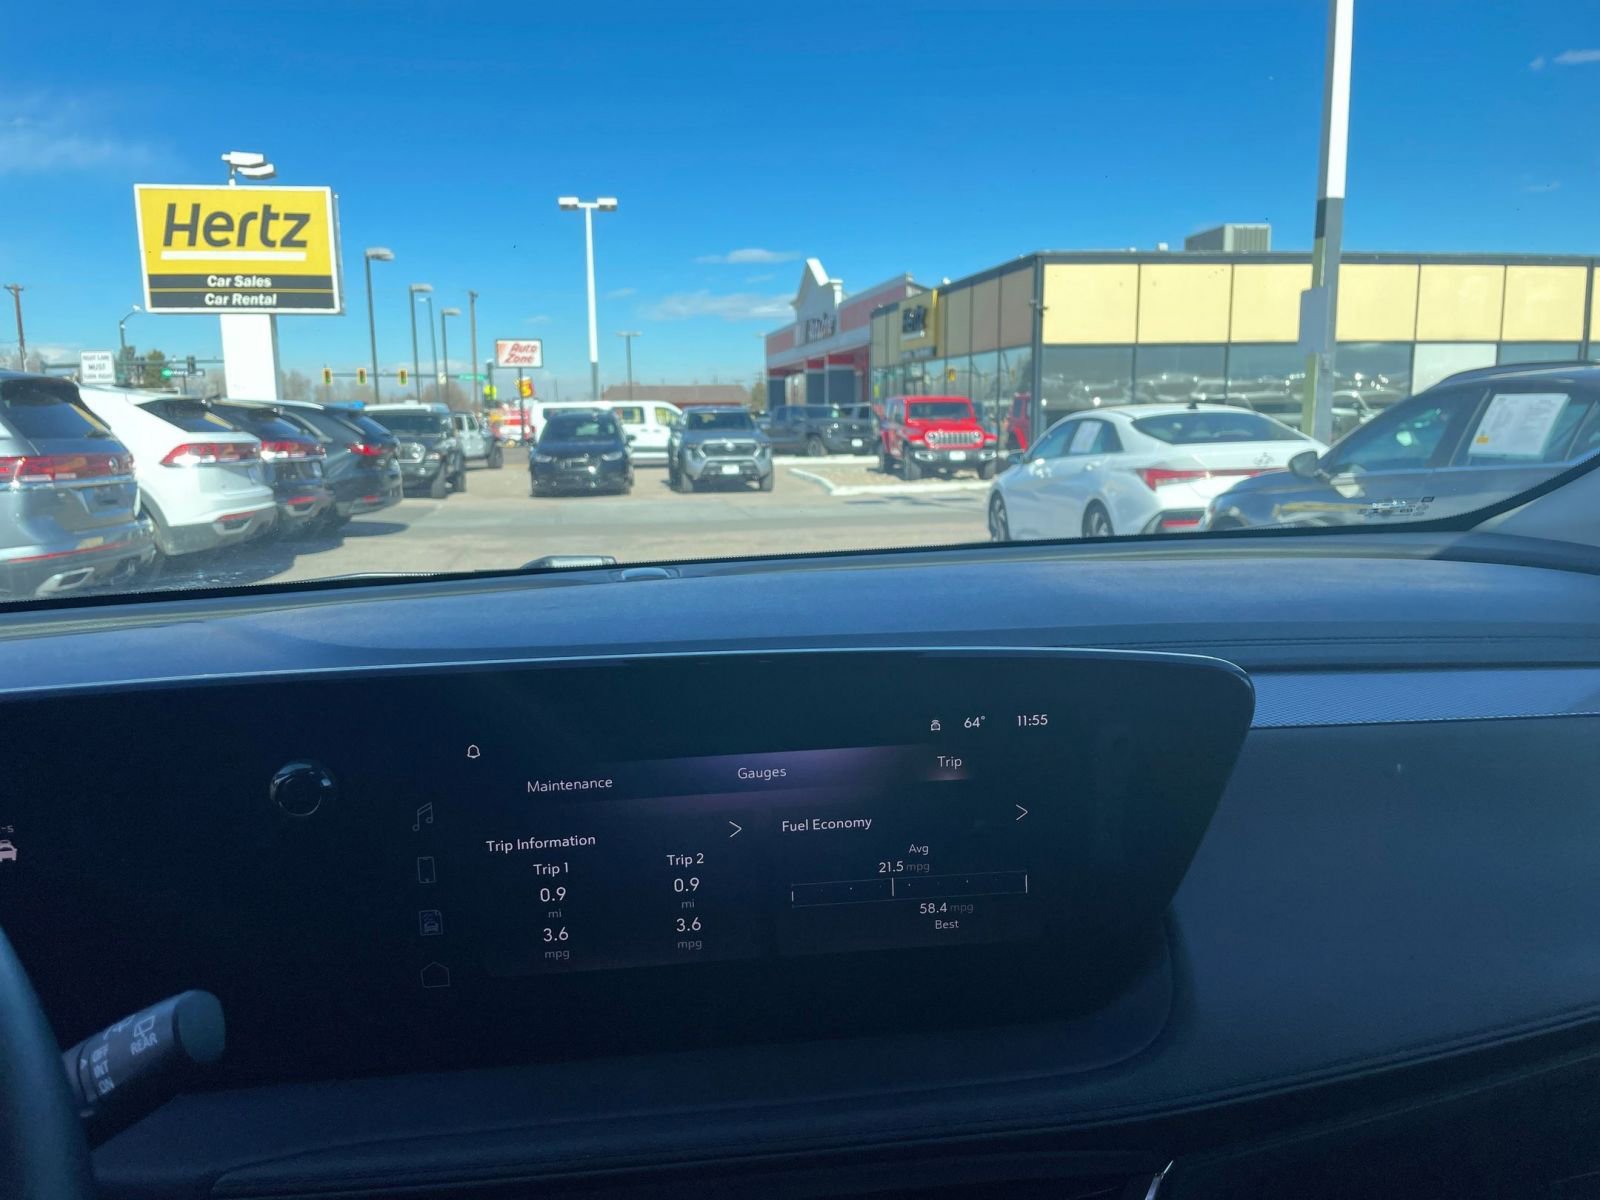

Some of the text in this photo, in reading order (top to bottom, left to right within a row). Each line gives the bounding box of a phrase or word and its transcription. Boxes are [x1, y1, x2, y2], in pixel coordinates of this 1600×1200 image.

[163, 203, 311, 248] Hertz
[207, 275, 272, 287] Car Sales
[204, 293, 277, 306] Car Rental
[511, 343, 538, 353] Auto
[506, 353, 534, 363] Zone
[1017, 714, 1048, 727] 11:55
[937, 755, 962, 769] Trip
[737, 766, 787, 780] Gauges
[527, 776, 613, 793] Maintenance
[782, 817, 872, 832] Fuel Economy
[486, 835, 596, 854] Trip Information
[908, 843, 929, 856] Avg
[666, 853, 704, 867] Trip 2
[533, 862, 569, 877] Trip 1
[879, 861, 930, 874] 21.5 mpg
[673, 877, 700, 893] 0.9
[539, 886, 567, 903] 0.9
[681, 899, 695, 909] mi
[919, 902, 974, 915] 58.4 mpg
[548, 909, 562, 919] mi
[676, 917, 702, 932] 3.6
[935, 919, 959, 930] Best
[543, 927, 569, 943] 3.6
[677, 940, 702, 951] mpg
[544, 950, 570, 960] mpg
[131, 1032, 158, 1055] REAR
